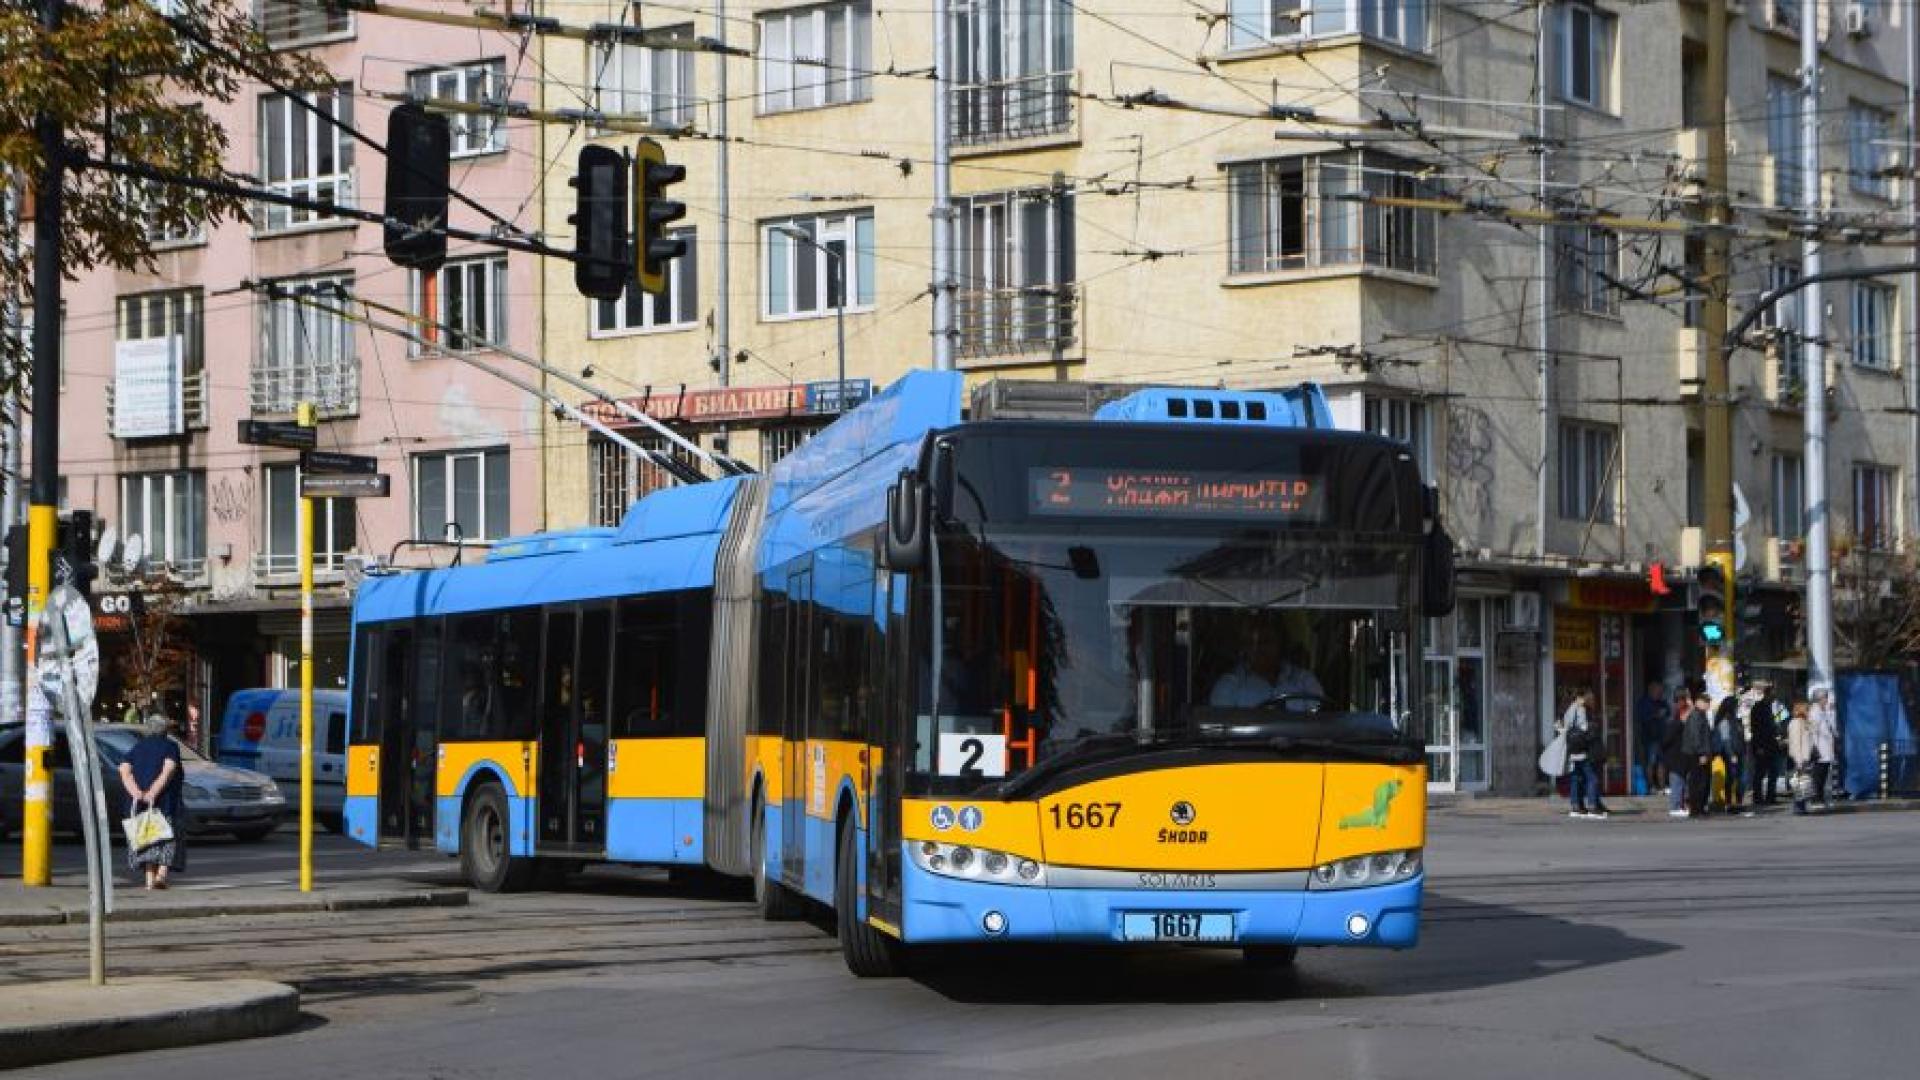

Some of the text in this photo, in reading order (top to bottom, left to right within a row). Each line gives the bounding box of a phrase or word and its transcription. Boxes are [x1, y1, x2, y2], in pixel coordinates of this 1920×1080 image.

[960, 738, 984, 777] 2
[1050, 803, 1121, 829] 1667
[1138, 873, 1216, 888] SOLARIS
[1152, 912, 1203, 937] 1667
